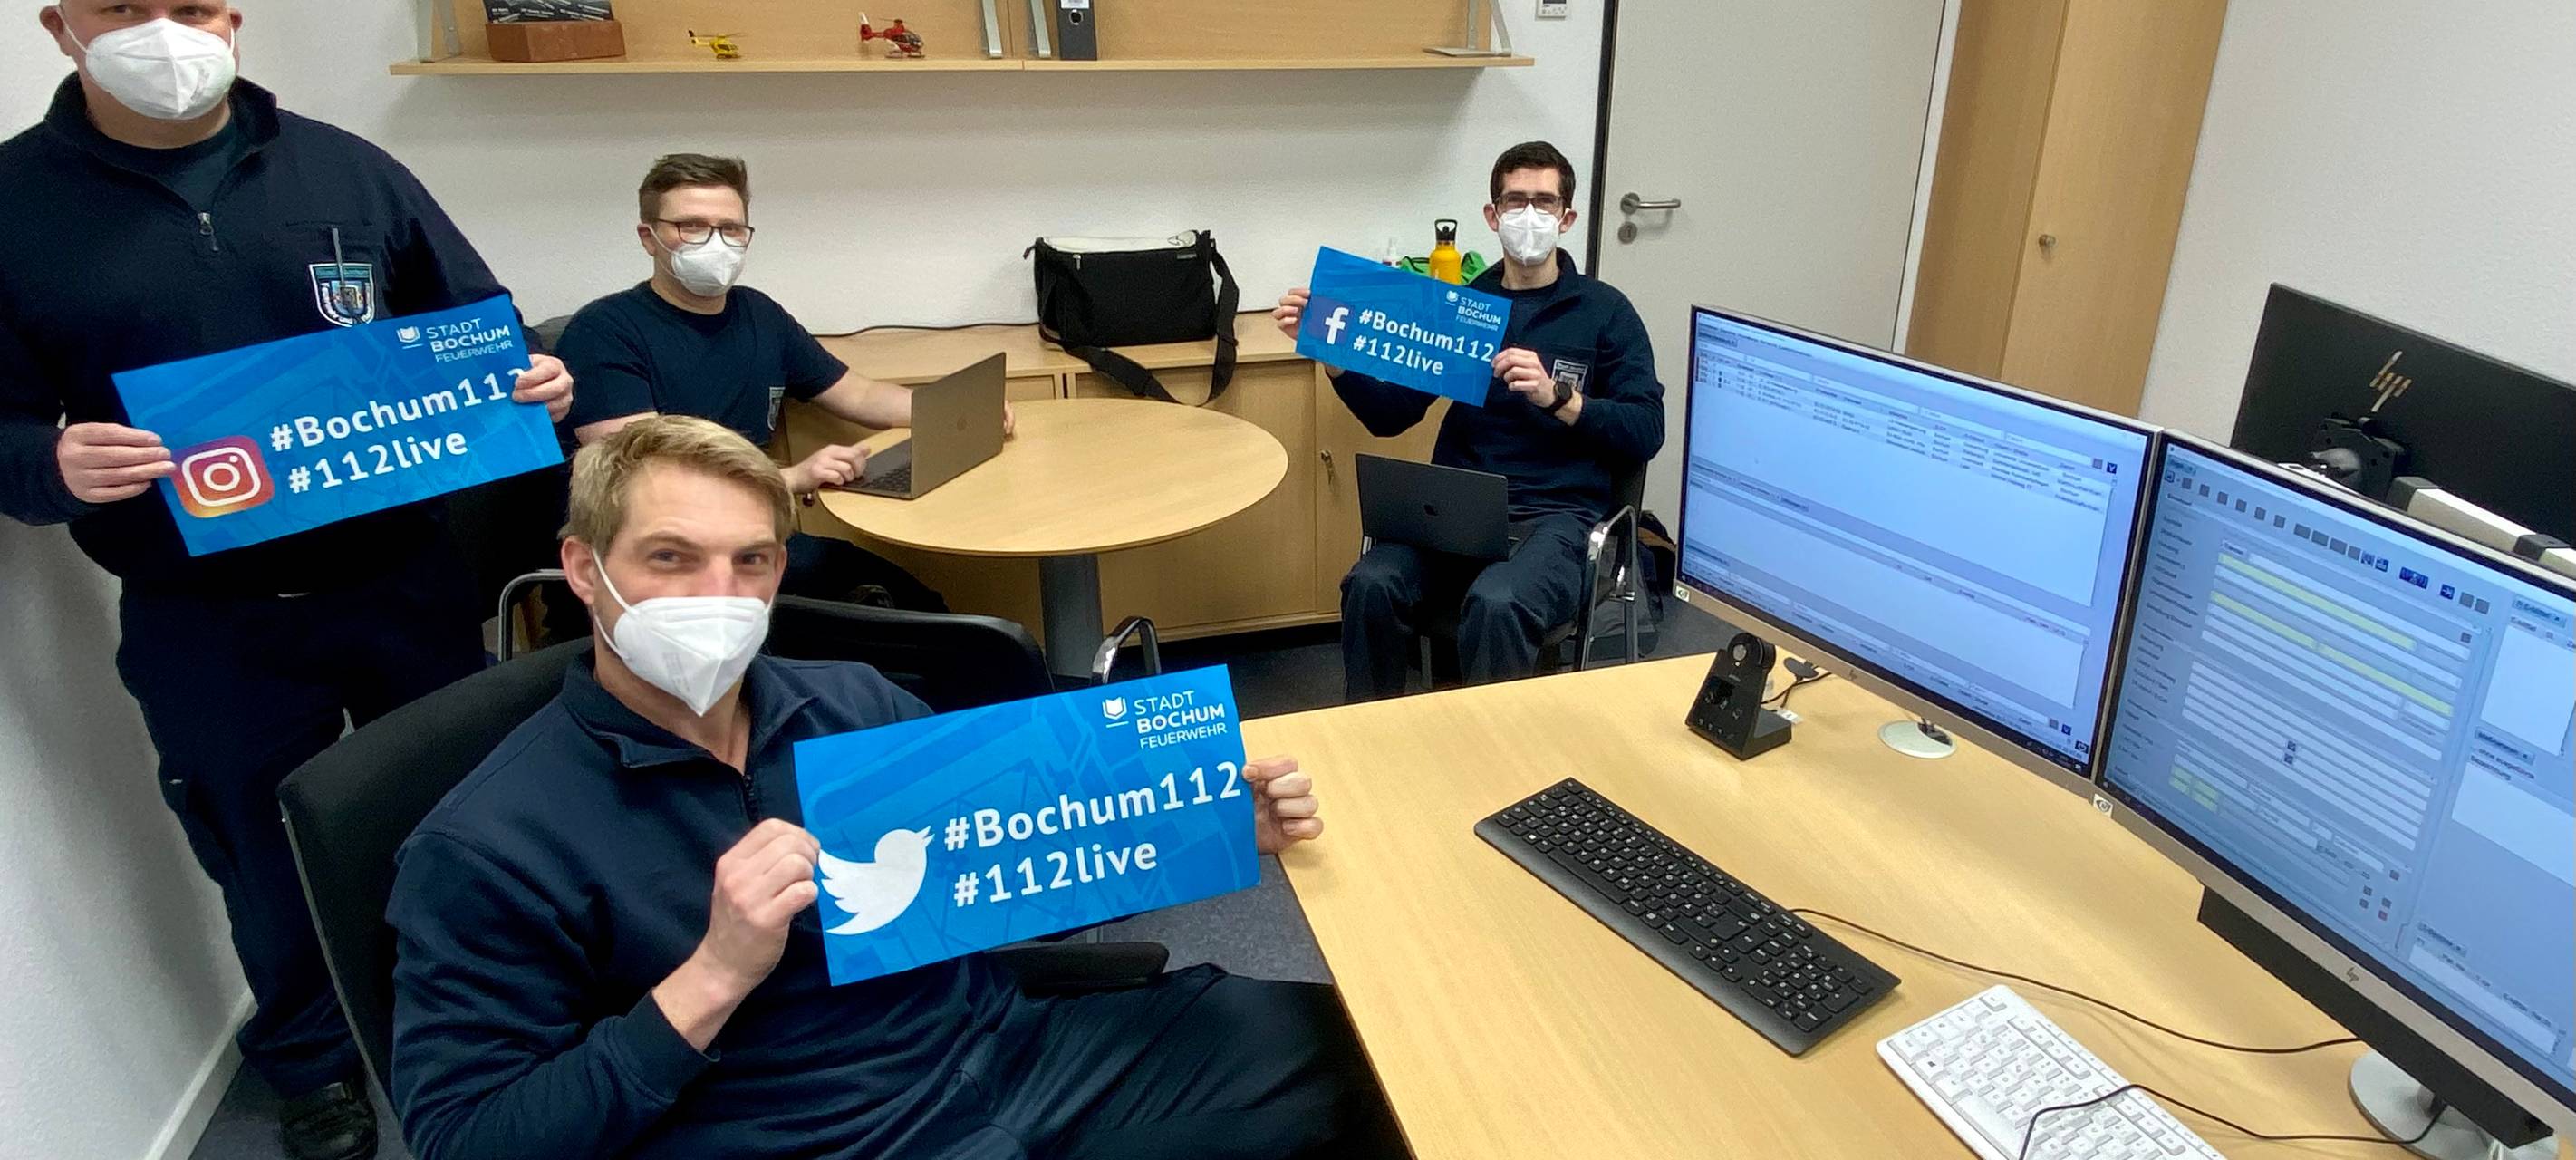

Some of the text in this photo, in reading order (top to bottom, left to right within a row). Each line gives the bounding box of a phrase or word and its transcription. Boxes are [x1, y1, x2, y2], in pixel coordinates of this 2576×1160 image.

[1457, 306, 1501, 324] BOCHUM
[1460, 297, 1491, 312] STADT
[426, 318, 481, 339] STADT
[430, 324, 510, 353] BOCHUM
[1359, 309, 1494, 362] #Bochum112
[435, 340, 514, 362] FEUERWEHR
[1353, 335, 1443, 375] #112live
[288, 430, 468, 494] #112live
[1134, 690, 1195, 715] STADT
[1137, 703, 1225, 734] BOCHUM
[1139, 722, 1227, 749] FEUERWEHR
[944, 761, 1241, 851] #Bochum112
[953, 841, 1157, 907] #112live
